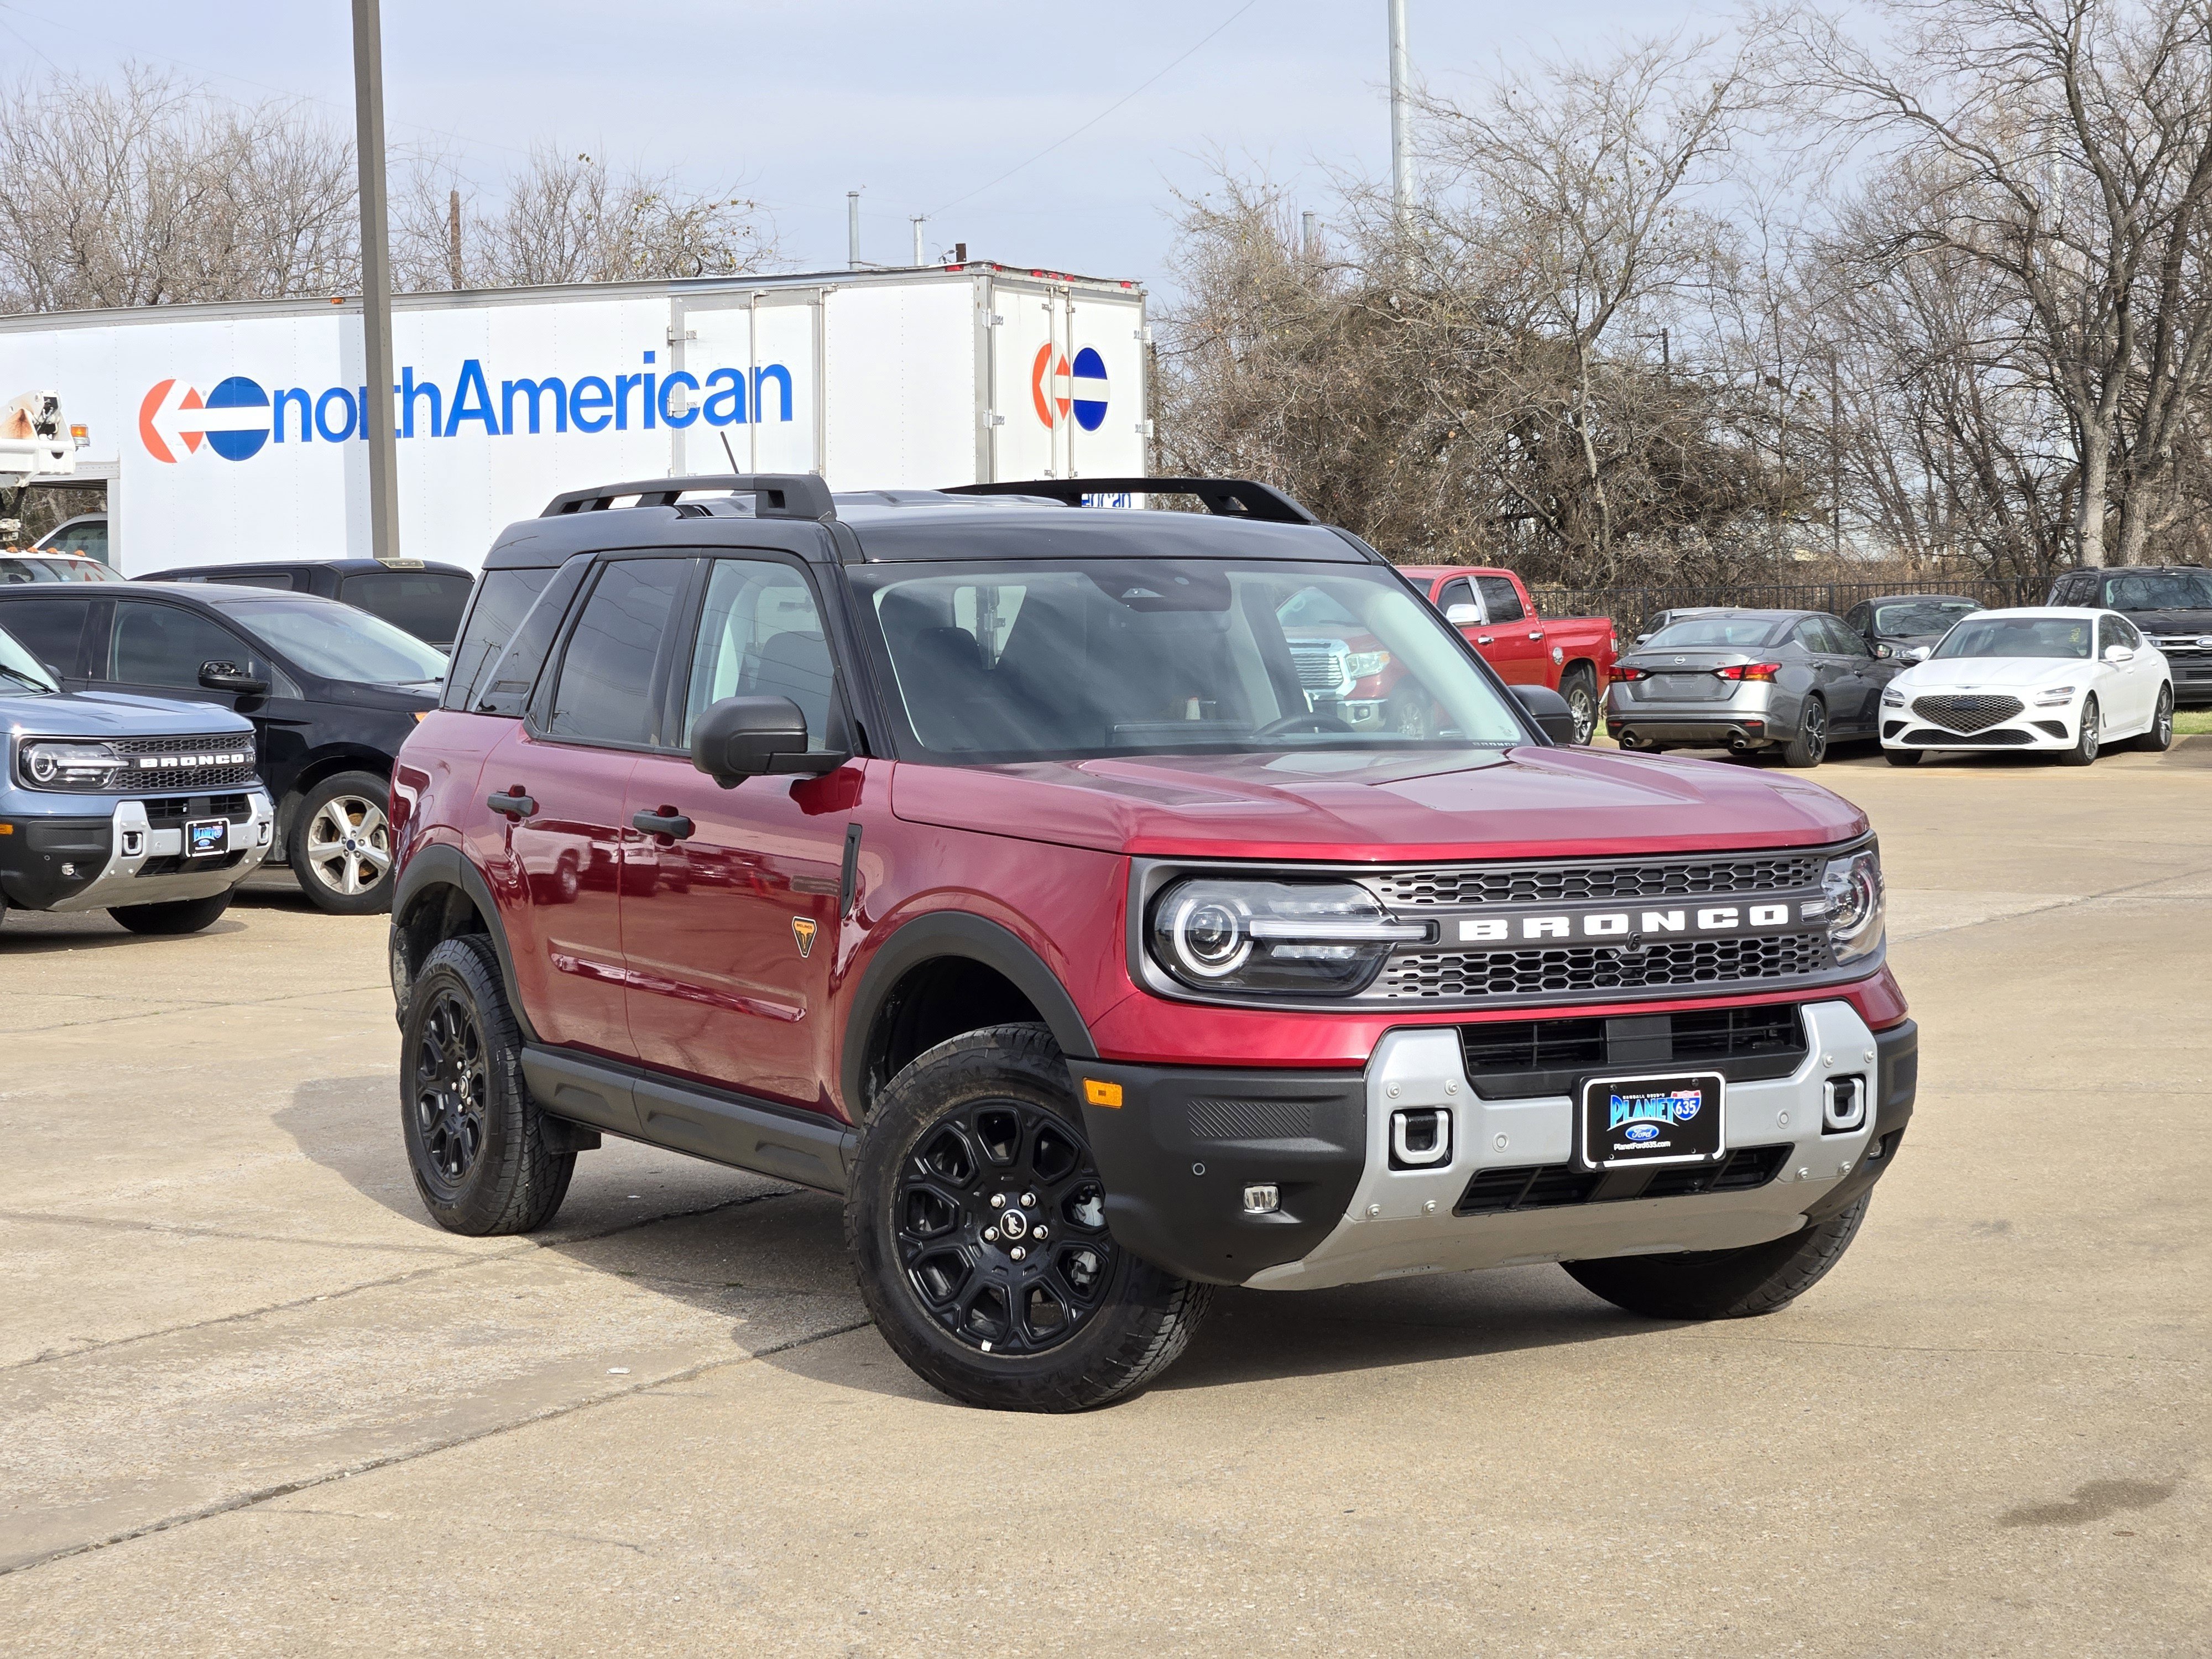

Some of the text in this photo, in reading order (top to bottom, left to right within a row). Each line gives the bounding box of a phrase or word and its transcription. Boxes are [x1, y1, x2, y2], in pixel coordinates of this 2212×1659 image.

[274, 351, 792, 443] nohAmerican
[140, 754, 244, 768] BRONCO
[1459, 904, 1788, 941] BRONCO
[1610, 1094, 1675, 1128] PLANET
[1676, 1100, 1696, 1115] 635
[1632, 1128, 1652, 1138] Ford
[1614, 1141, 1671, 1150] PlanetFord635.com
